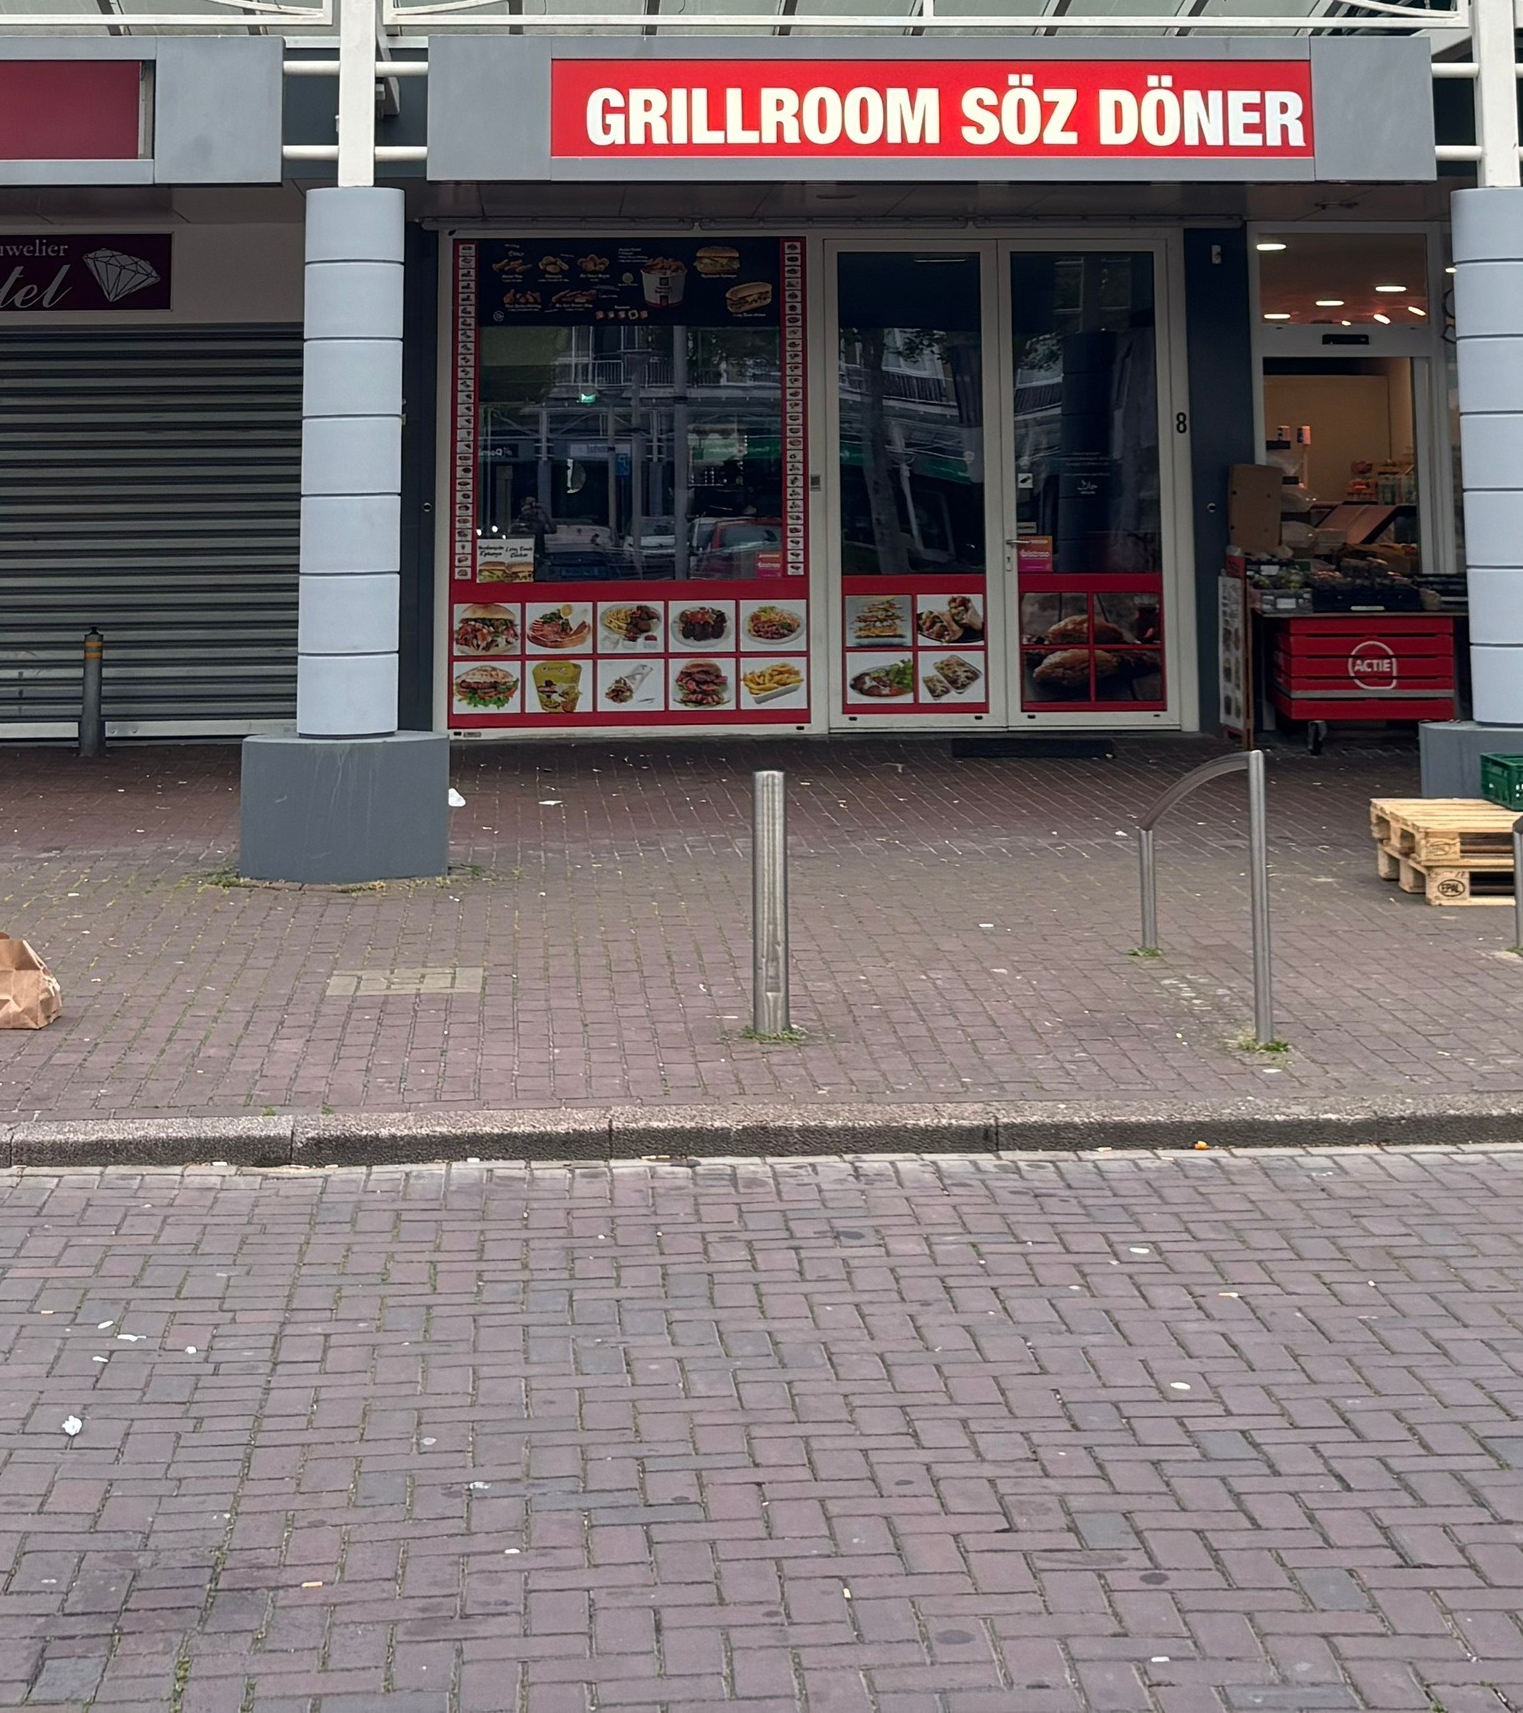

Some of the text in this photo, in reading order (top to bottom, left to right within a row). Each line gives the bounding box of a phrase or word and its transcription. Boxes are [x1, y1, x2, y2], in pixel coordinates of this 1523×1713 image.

[586, 73, 1307, 147] GRILLROOM SÖZ DÖNER
[1176, 412, 1187, 434] 8
[1354, 659, 1391, 672] ACTIE
